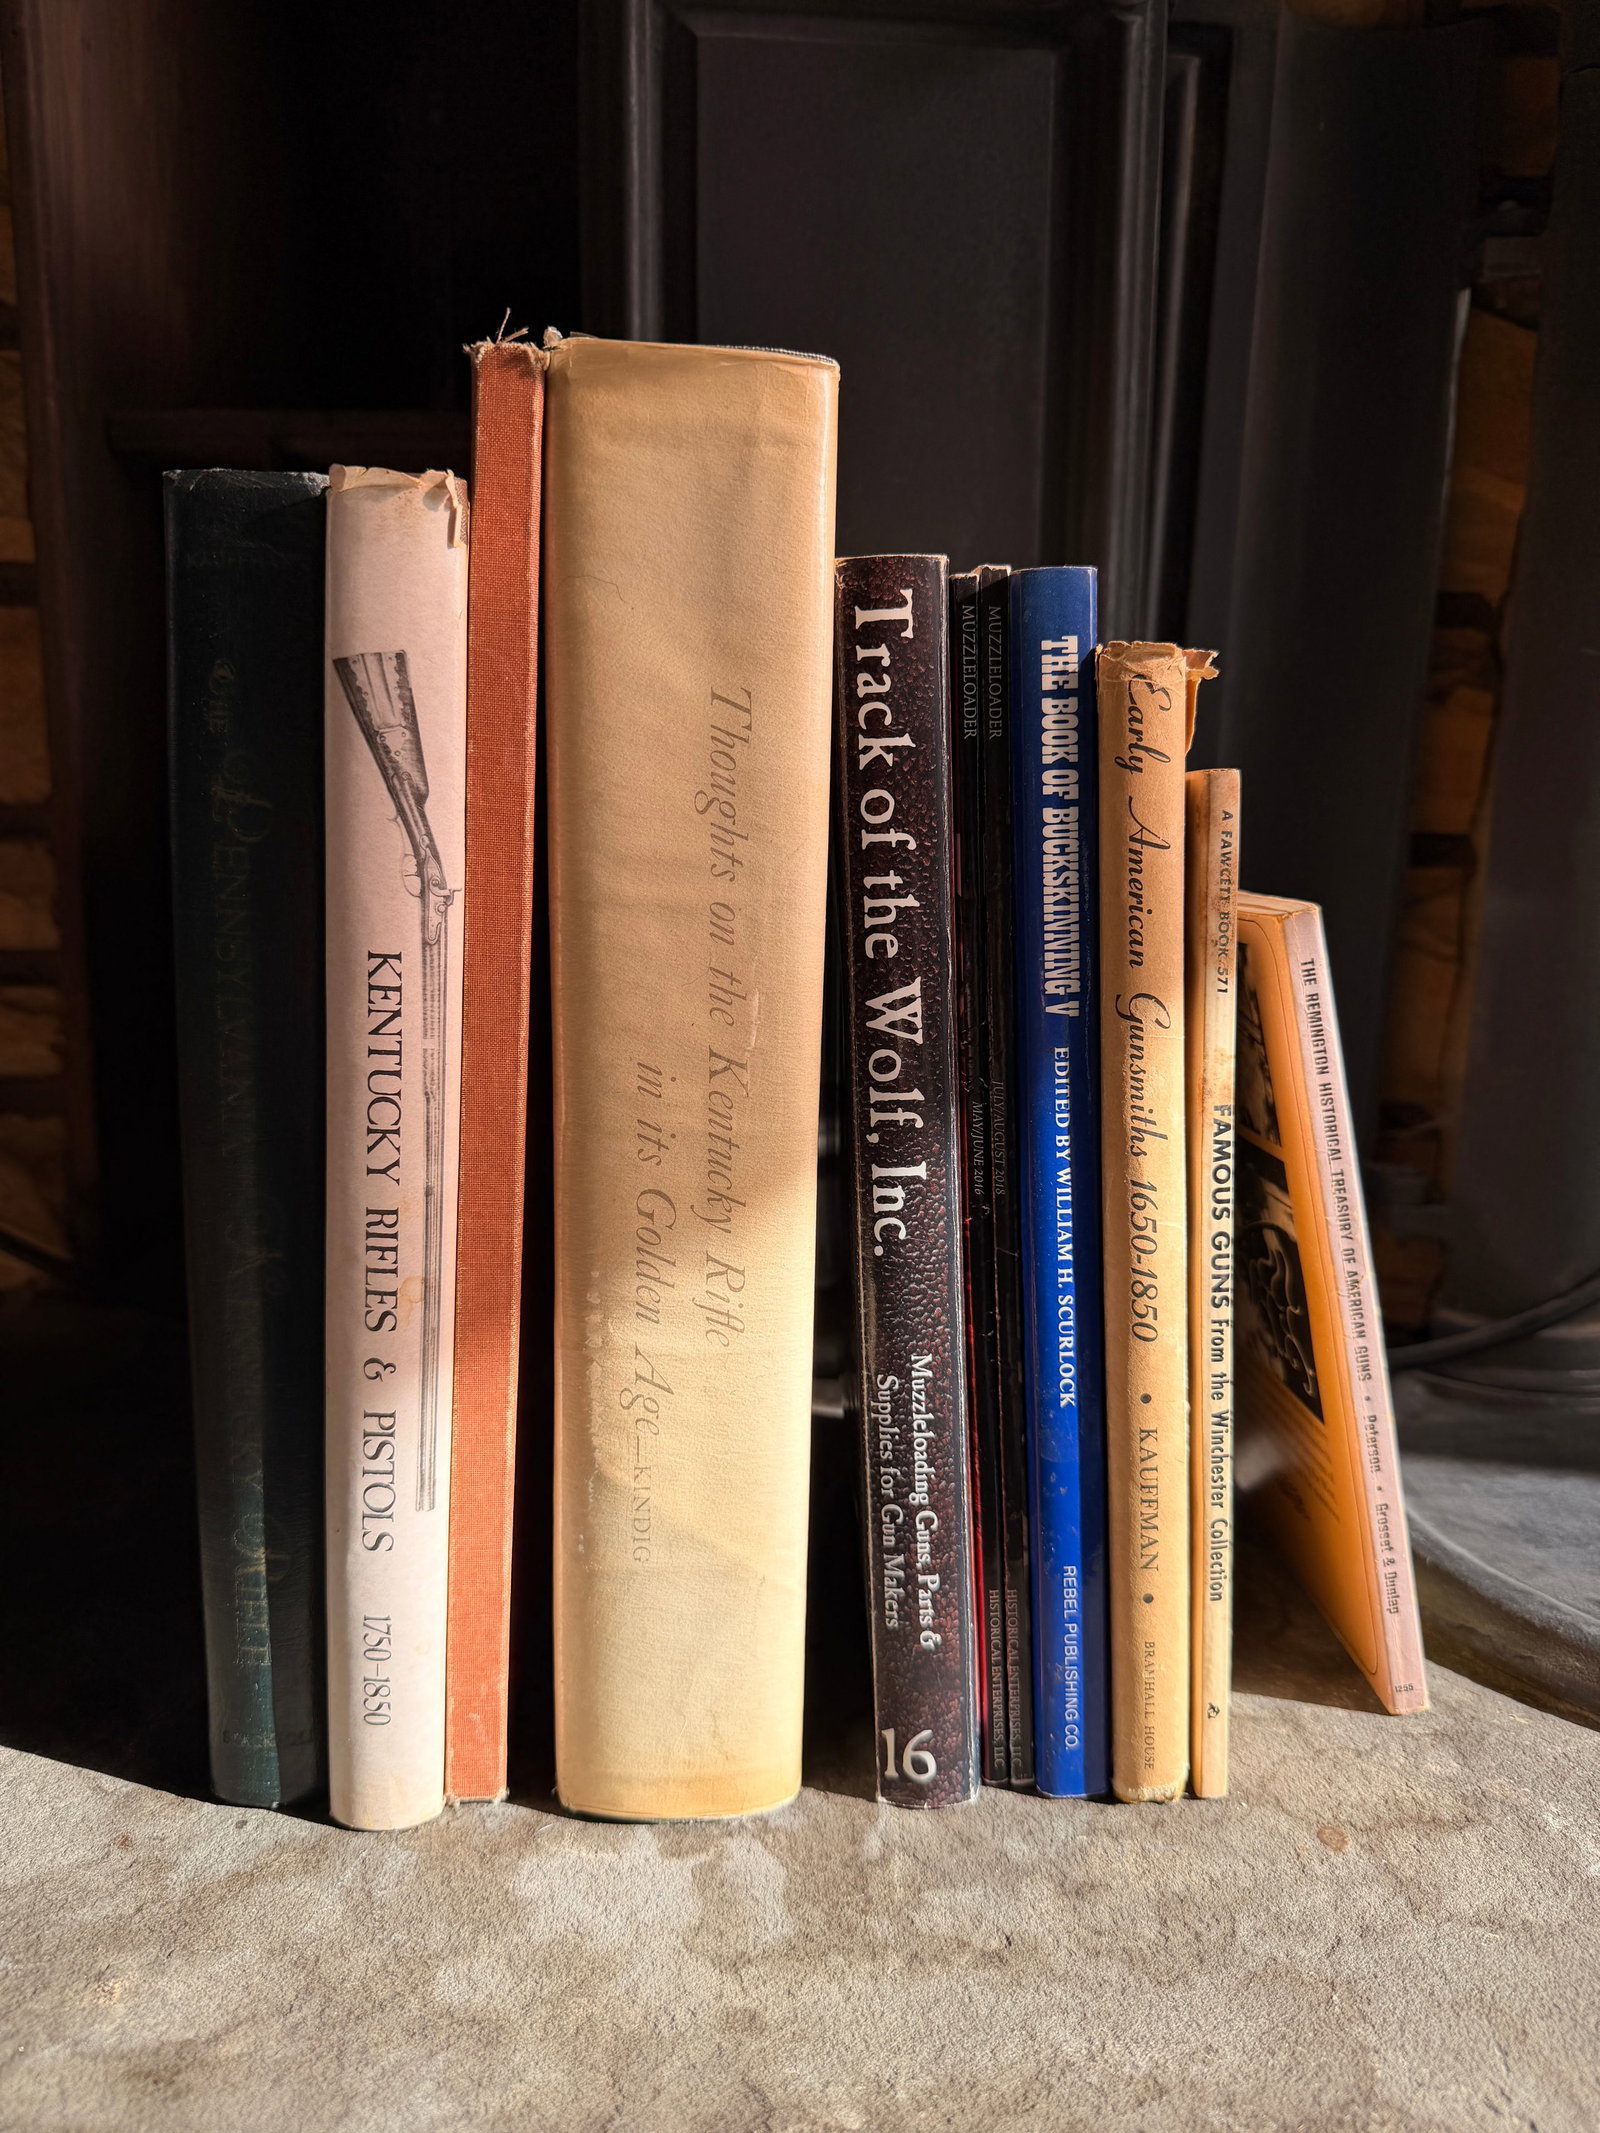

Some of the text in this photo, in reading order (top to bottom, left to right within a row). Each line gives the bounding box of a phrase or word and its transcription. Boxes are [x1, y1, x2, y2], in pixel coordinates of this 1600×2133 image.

[987, 605, 1003, 740] MUZZLELOADER
[853, 588, 928, 1258] Track of the Wolf, Inc.
[1301, 958, 1318, 986] THE
[690, 686, 753, 1348] Thoughts on the Kentucky Rifle
[1305, 993, 1330, 1076] REMINGTON
[636, 1061, 677, 1100] in
[636, 1119, 677, 1168] its
[991, 1080, 1006, 1166] JULY/AUGUST
[1318, 1082, 1342, 1166] HISTORICAL
[961, 604, 1008, 1768] MUZZLELOADER MAY/JUNE 2016 HISTORICAL ENTERPRISES, LLC
[994, 1169, 1006, 1195] 2018
[1041, 635, 1081, 1750] THE BOOK OF BUCKSKINNING V EDITED BY WILLIAM H. SCURLOCK REBEL PUBLISHING CO.
[1114, 673, 1172, 1770] Early American Gunsmiths 1650-1850 KAUFFMAN BRAMHALL HOUSE
[1209, 809, 1234, 1603] A FAWCETT BOOK 571 FAMOUS GUNS From the Winchester Collection
[1331, 1169, 1354, 1240] TREASURY
[634, 1187, 678, 1326] Golden
[1343, 1248, 1357, 1265] OF
[361, 950, 403, 1726] KENTUCKY RIFLES & PISTOLS 1750-1850
[1346, 1269, 1367, 1339] AMERICAN
[1354, 1346, 1372, 1382] GUNS
[1363, 1414, 1382, 1474] Peterson
[870, 1374, 907, 1632] Supplies for Gun Makers
[908, 1352, 943, 1651] Muzzleloading Guns, Parts &
[1376, 1503, 1393, 1552] Grosset
[1006, 1589, 1020, 1664] HISTORICAL
[1384, 1571, 1400, 1616] Dunlap
[1394, 1683, 1414, 1693] 1255
[881, 1727, 938, 1786] 16
